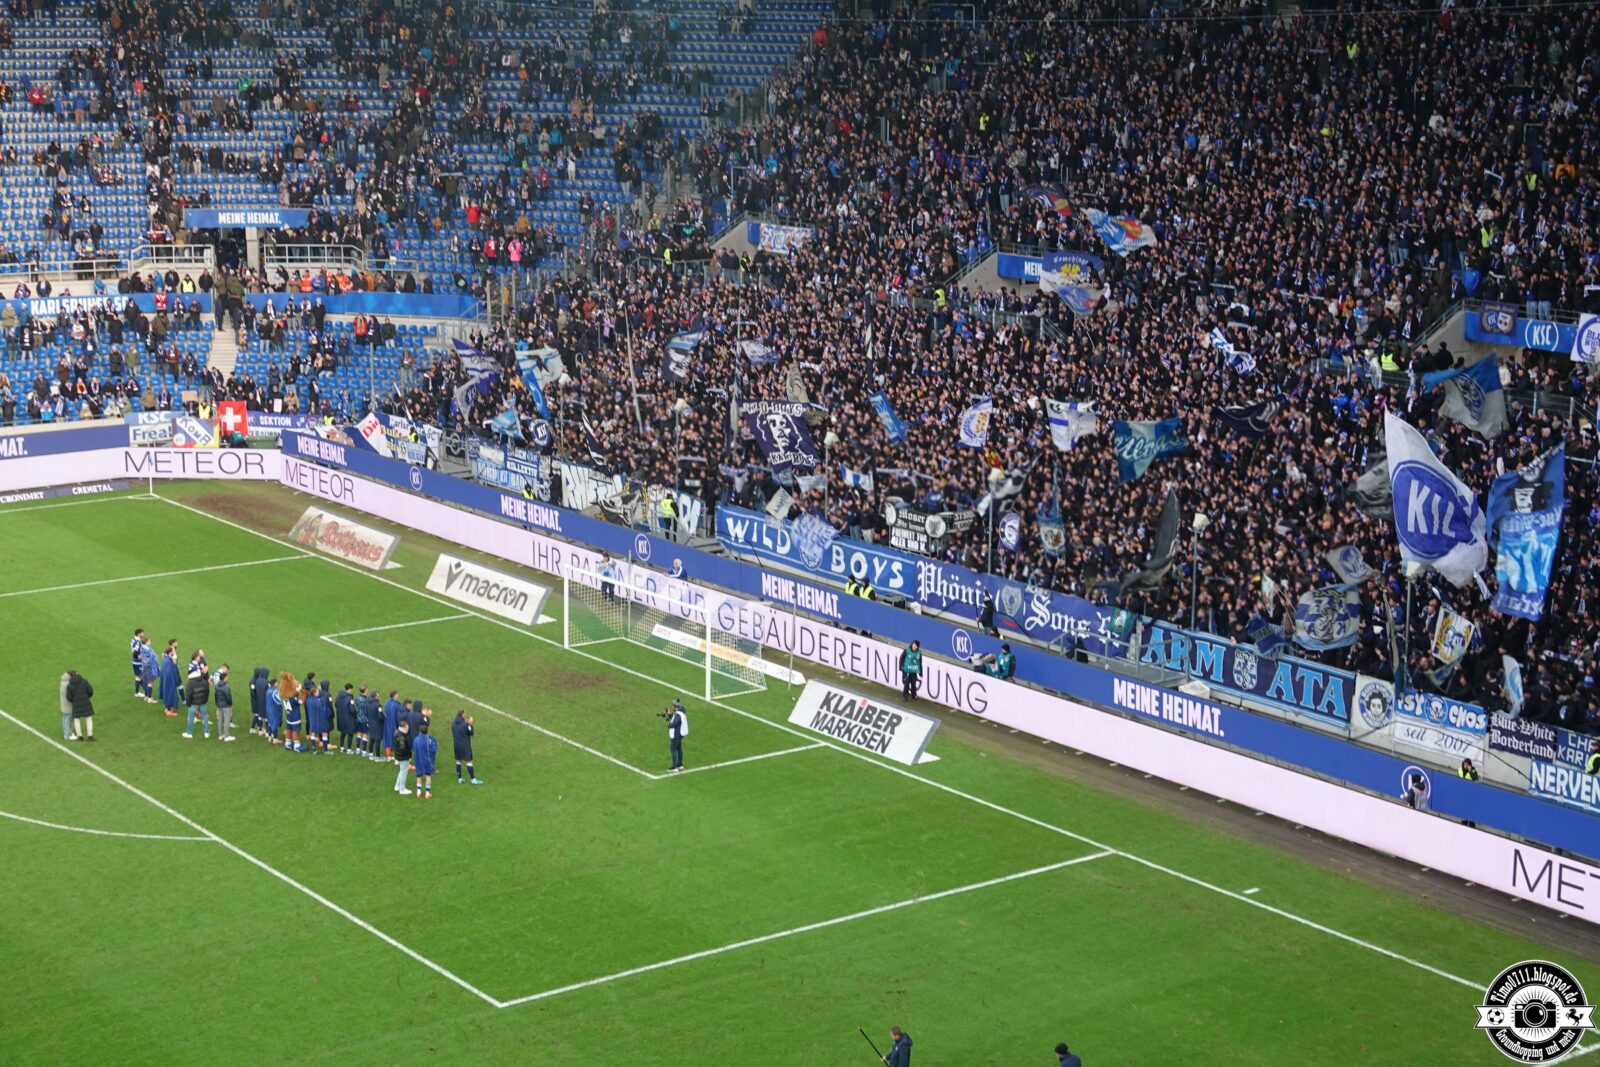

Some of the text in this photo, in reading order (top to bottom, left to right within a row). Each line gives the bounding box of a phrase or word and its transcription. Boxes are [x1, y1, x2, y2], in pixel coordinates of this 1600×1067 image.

[218, 212, 282, 224] MEINE HEIMAT.
[30, 297, 114, 316] KARLSRUHE
[1532, 324, 1552, 346] KSC
[138, 411, 172, 424] KSC
[260, 416, 292, 427] SEKTION
[124, 451, 264, 476] METEOR
[296, 435, 347, 466] MEINE HEIMAT.
[72, 484, 113, 494] CREMETAL
[285, 459, 355, 503] METEOR
[0, 492, 44, 503] CRONIMET
[500, 494, 562, 532] MEINE HEIMAT.
[726, 517, 791, 555] WILD
[831, 543, 904, 589] BOYS
[460, 572, 529, 612] macron
[762, 572, 842, 620] MEINE HEIMAT.
[532, 540, 562, 574] IHR
[571, 554, 657, 607] PANER
[718, 602, 989, 714] GEBÄUDEREINIUNG
[956, 635, 968, 654] KSC
[1266, 662, 1348, 720] ATA
[1114, 678, 1224, 737] MEINE HEIMAT.
[1448, 704, 1487, 730] CHOS
[810, 710, 892, 754] MARKISEN
[1404, 726, 1473, 754] seit 2007
[1490, 712, 1556, 742] Blue-White
[1490, 728, 1554, 758] Borderland
[1512, 848, 1600, 910] ME
